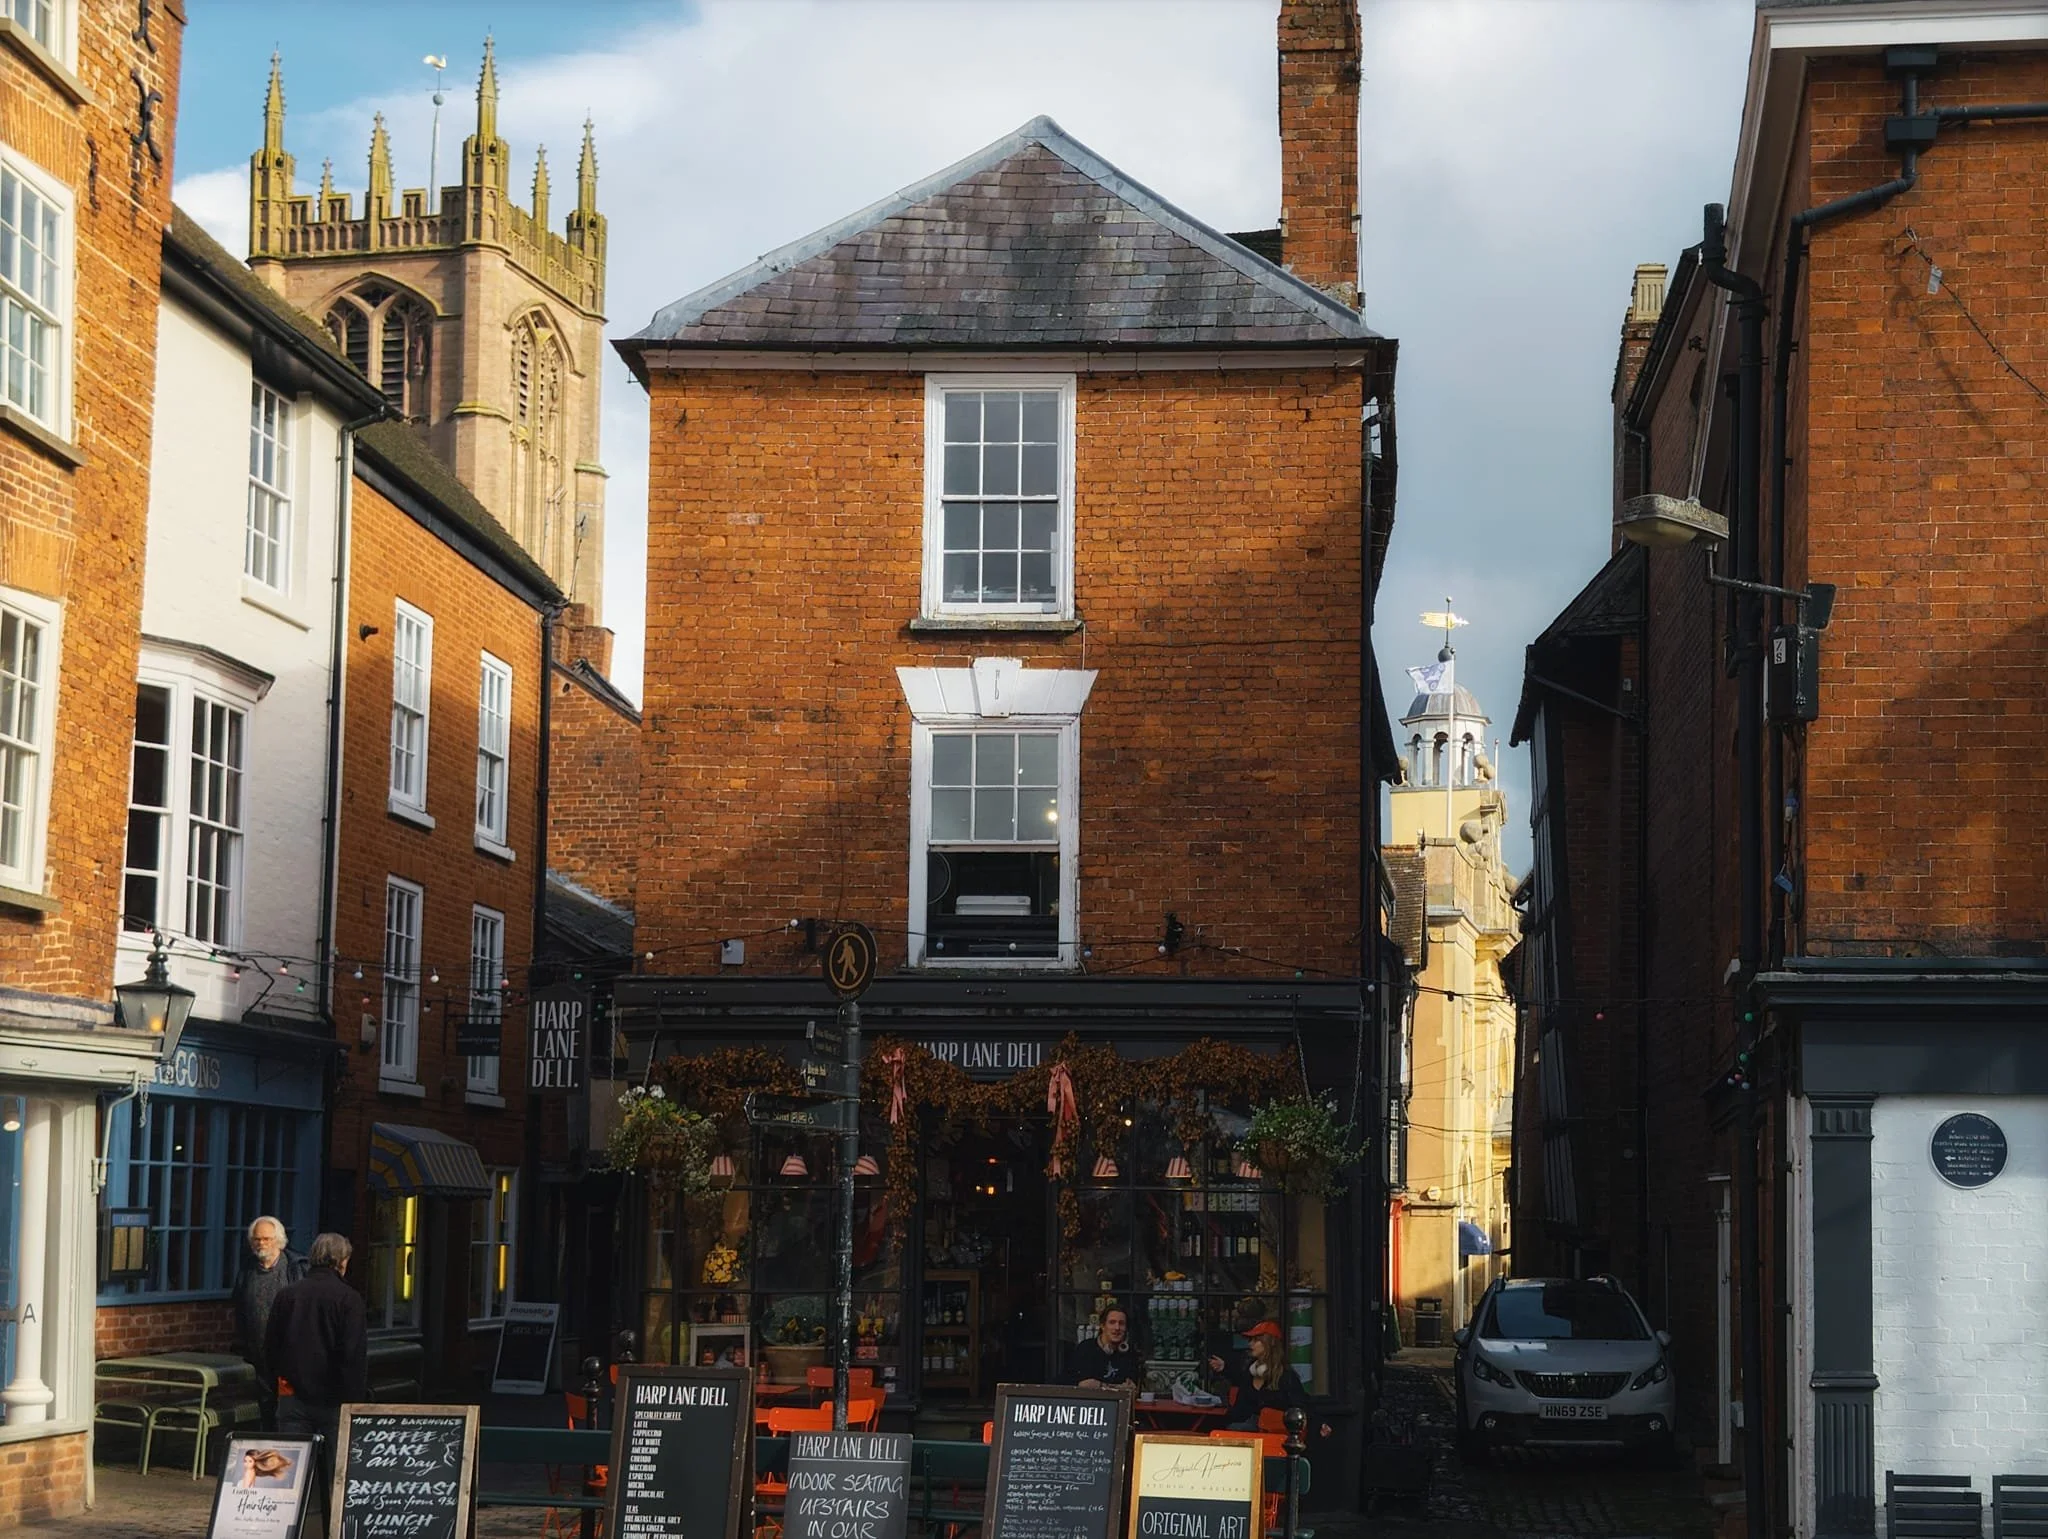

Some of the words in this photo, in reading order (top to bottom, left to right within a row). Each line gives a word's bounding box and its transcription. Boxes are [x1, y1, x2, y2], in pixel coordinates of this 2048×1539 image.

[534, 1001, 583, 1029] HARP
[533, 1030, 580, 1059] LANE
[963, 1042, 1002, 1068] LANE
[532, 1059, 579, 1088] DELI.
[636, 1385, 666, 1404] HARP
[668, 1386, 698, 1405] LANE
[700, 1387, 729, 1406] DELI.
[1014, 1403, 1046, 1423] HARP
[1047, 1405, 1077, 1425] LANE
[1078, 1406, 1108, 1426] DELI.
[1545, 1405, 1576, 1417] HN69
[633, 1420, 648, 1428] LATTE
[363, 1430, 438, 1442] COFFEE
[632, 1438, 644, 1446] FLAT
[645, 1438, 661, 1446] WHITE
[371, 1444, 430, 1456] CAKE
[797, 1436, 830, 1457] HARP
[833, 1436, 865, 1459] LANE
[869, 1438, 902, 1460] DELI.
[404, 1456, 441, 1476] Day
[628, 1472, 654, 1480] ESPRESSO
[347, 1480, 457, 1495] BREAKFAST
[628, 1481, 645, 1489] MOCHA
[789, 1472, 836, 1491] INDOOR
[842, 1473, 903, 1499] SEATING
[627, 1490, 637, 1498] HOT
[637, 1490, 665, 1499] CHOCOLATE
[345, 1495, 370, 1508] Sat
[374, 1495, 401, 1510] Sun
[404, 1496, 434, 1513] from
[626, 1504, 639, 1514] TEAS
[799, 1497, 890, 1519] UPSTAIRS
[364, 1514, 440, 1527] LUNCH
[623, 1523, 641, 1531] LEMON
[1142, 1511, 1211, 1538] ORIGINAL
[1218, 1516, 1247, 1539] ART
[367, 1526, 397, 1538] from
[403, 1526, 419, 1535] 12
[807, 1520, 827, 1538] IN
[831, 1521, 877, 1539] OUR
